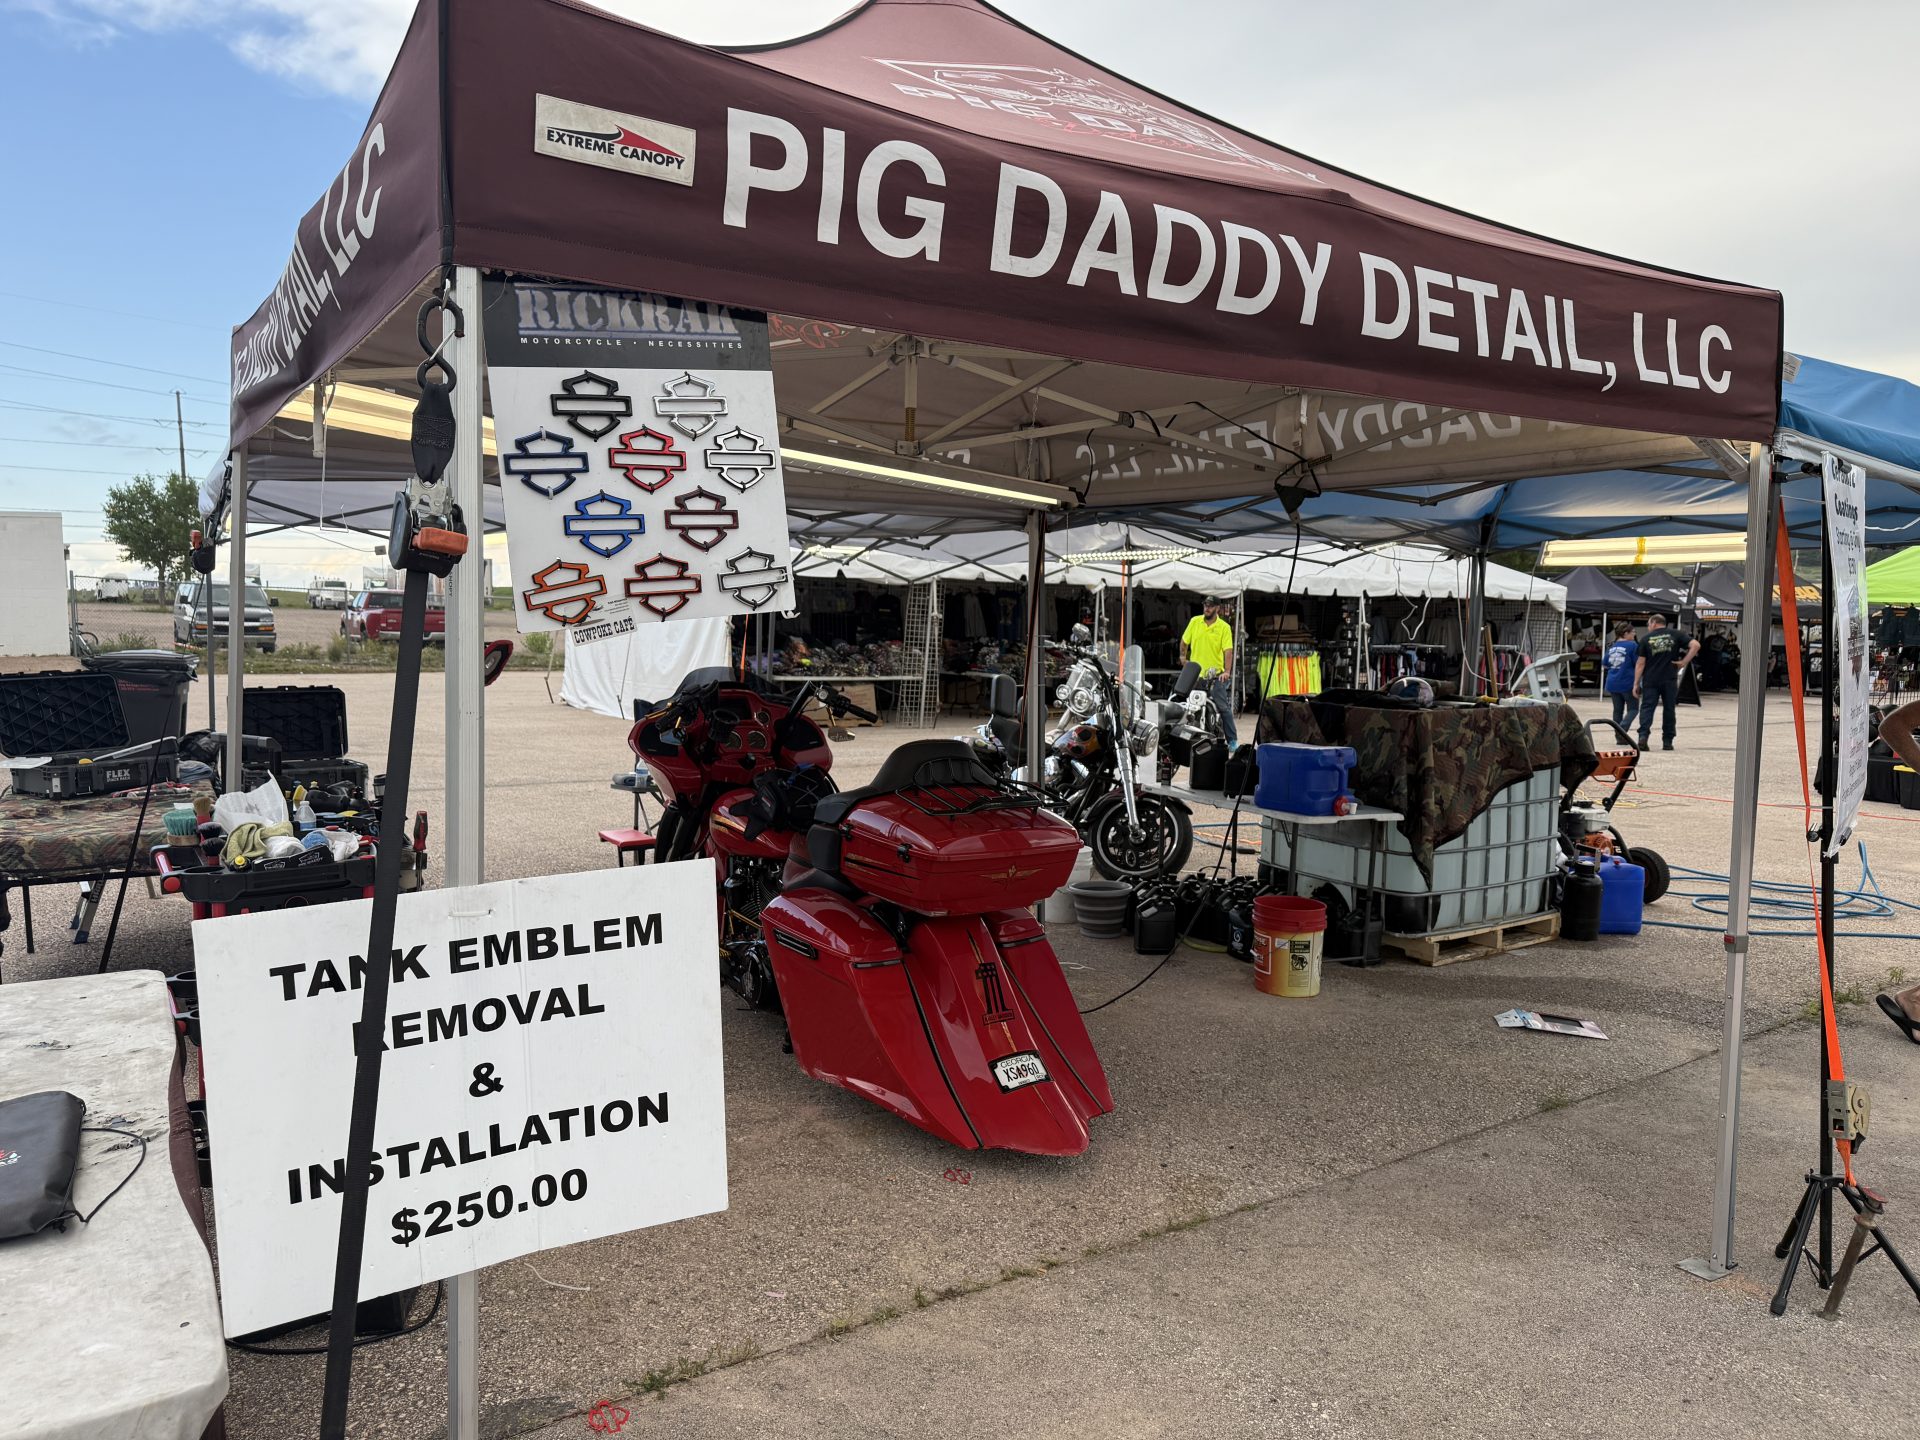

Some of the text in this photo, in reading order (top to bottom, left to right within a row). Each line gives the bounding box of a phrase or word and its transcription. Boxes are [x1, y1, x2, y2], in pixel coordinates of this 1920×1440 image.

[546, 127, 686, 171] EXTREME CANOPY
[275, 230, 342, 362] DETAIL,
[319, 121, 387, 278] LLC
[722, 106, 1733, 395] PIG DADDY DETAIL, LLC
[515, 288, 740, 334] RICKRAK
[519, 337, 743, 350] MOTORCYCLE NECESSITIES
[1834, 492, 1859, 526] Coatings
[573, 615, 636, 644] COWPOKE CAFÉ
[106, 768, 131, 779] FLEX
[448, 912, 664, 975] EMBLEM
[352, 983, 606, 1058] EMOVAL
[468, 1061, 505, 1098] &
[1000, 1055, 1034, 1068] GEORGIA
[1002, 1062, 1040, 1083] XSA960
[287, 1091, 670, 1205] INSTALLATION
[391, 1167, 589, 1248] $250.00
